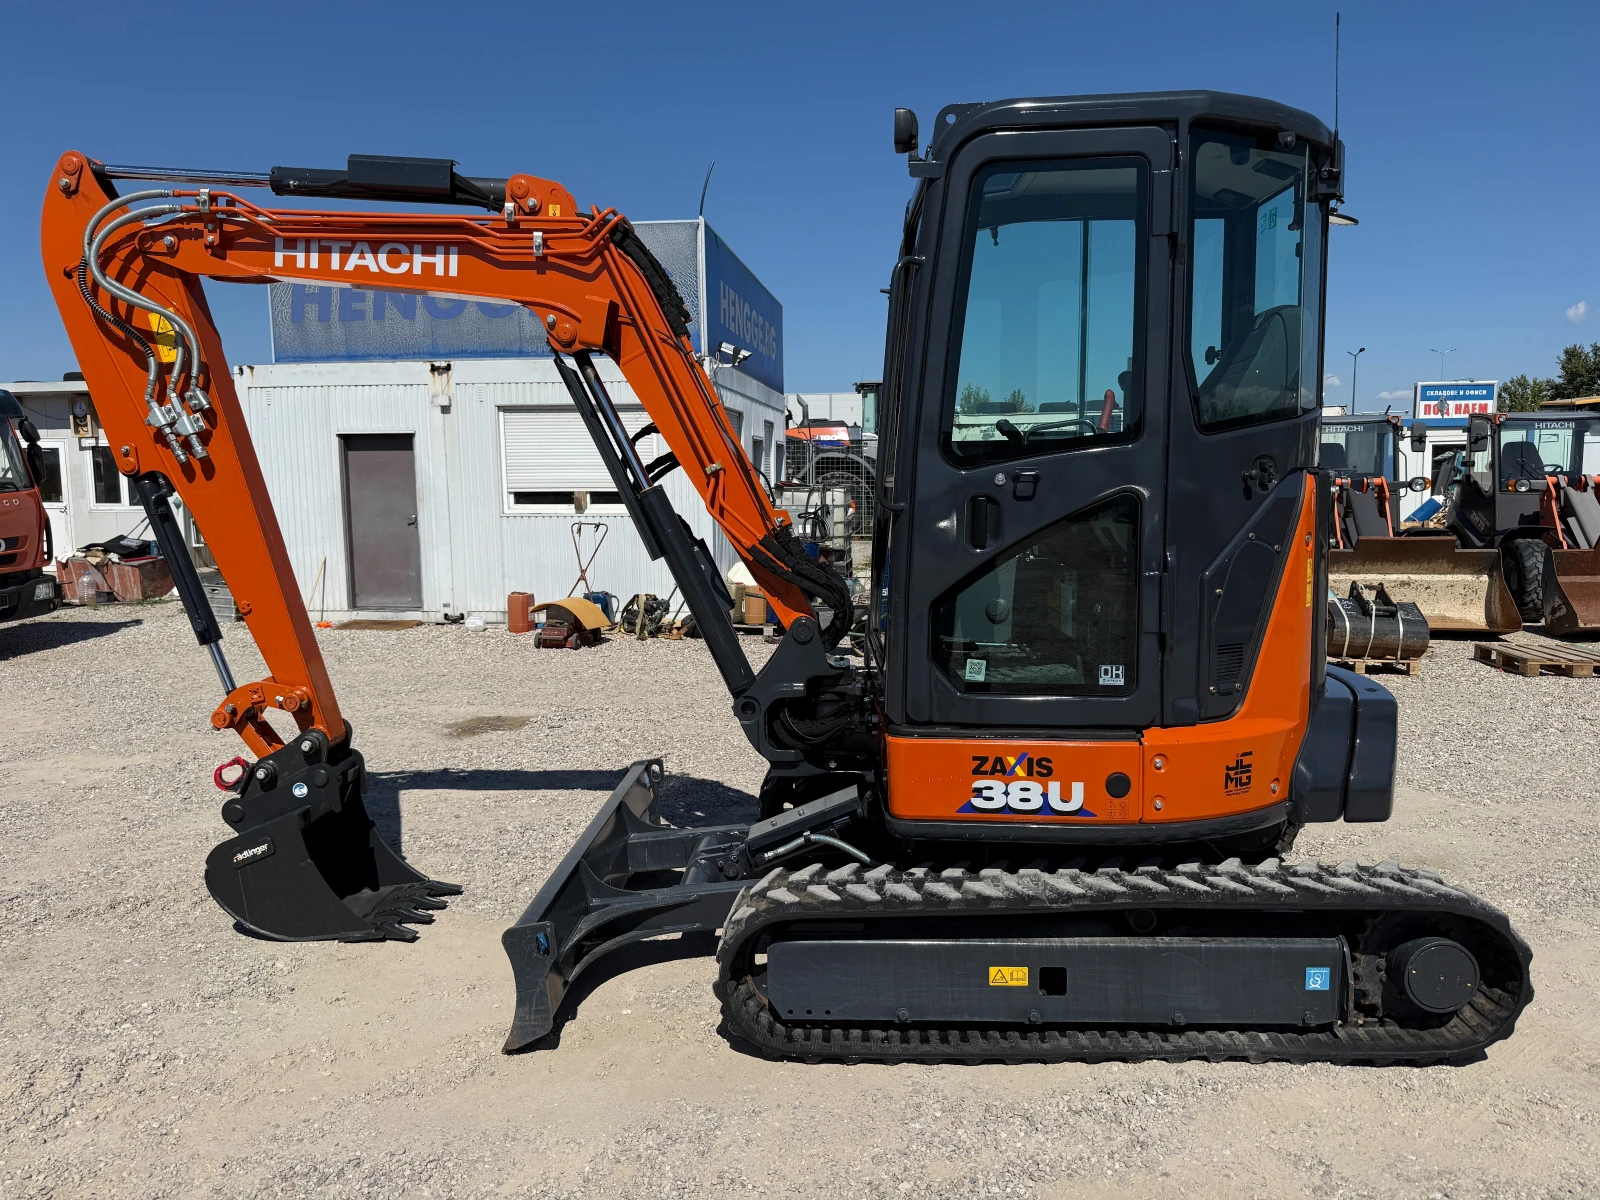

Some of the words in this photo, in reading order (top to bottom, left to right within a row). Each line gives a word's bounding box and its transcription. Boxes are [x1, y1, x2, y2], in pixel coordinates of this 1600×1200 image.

[274, 237, 458, 277] HITACHI
[720, 280, 776, 362] HENGGE.BG
[1454, 403, 1489, 415] НАЕМ
[1325, 425, 1364, 433] HITACHI
[1534, 421, 1576, 429] HITACHI
[971, 752, 1054, 777] ZAXIS
[970, 779, 1085, 816] 38U
